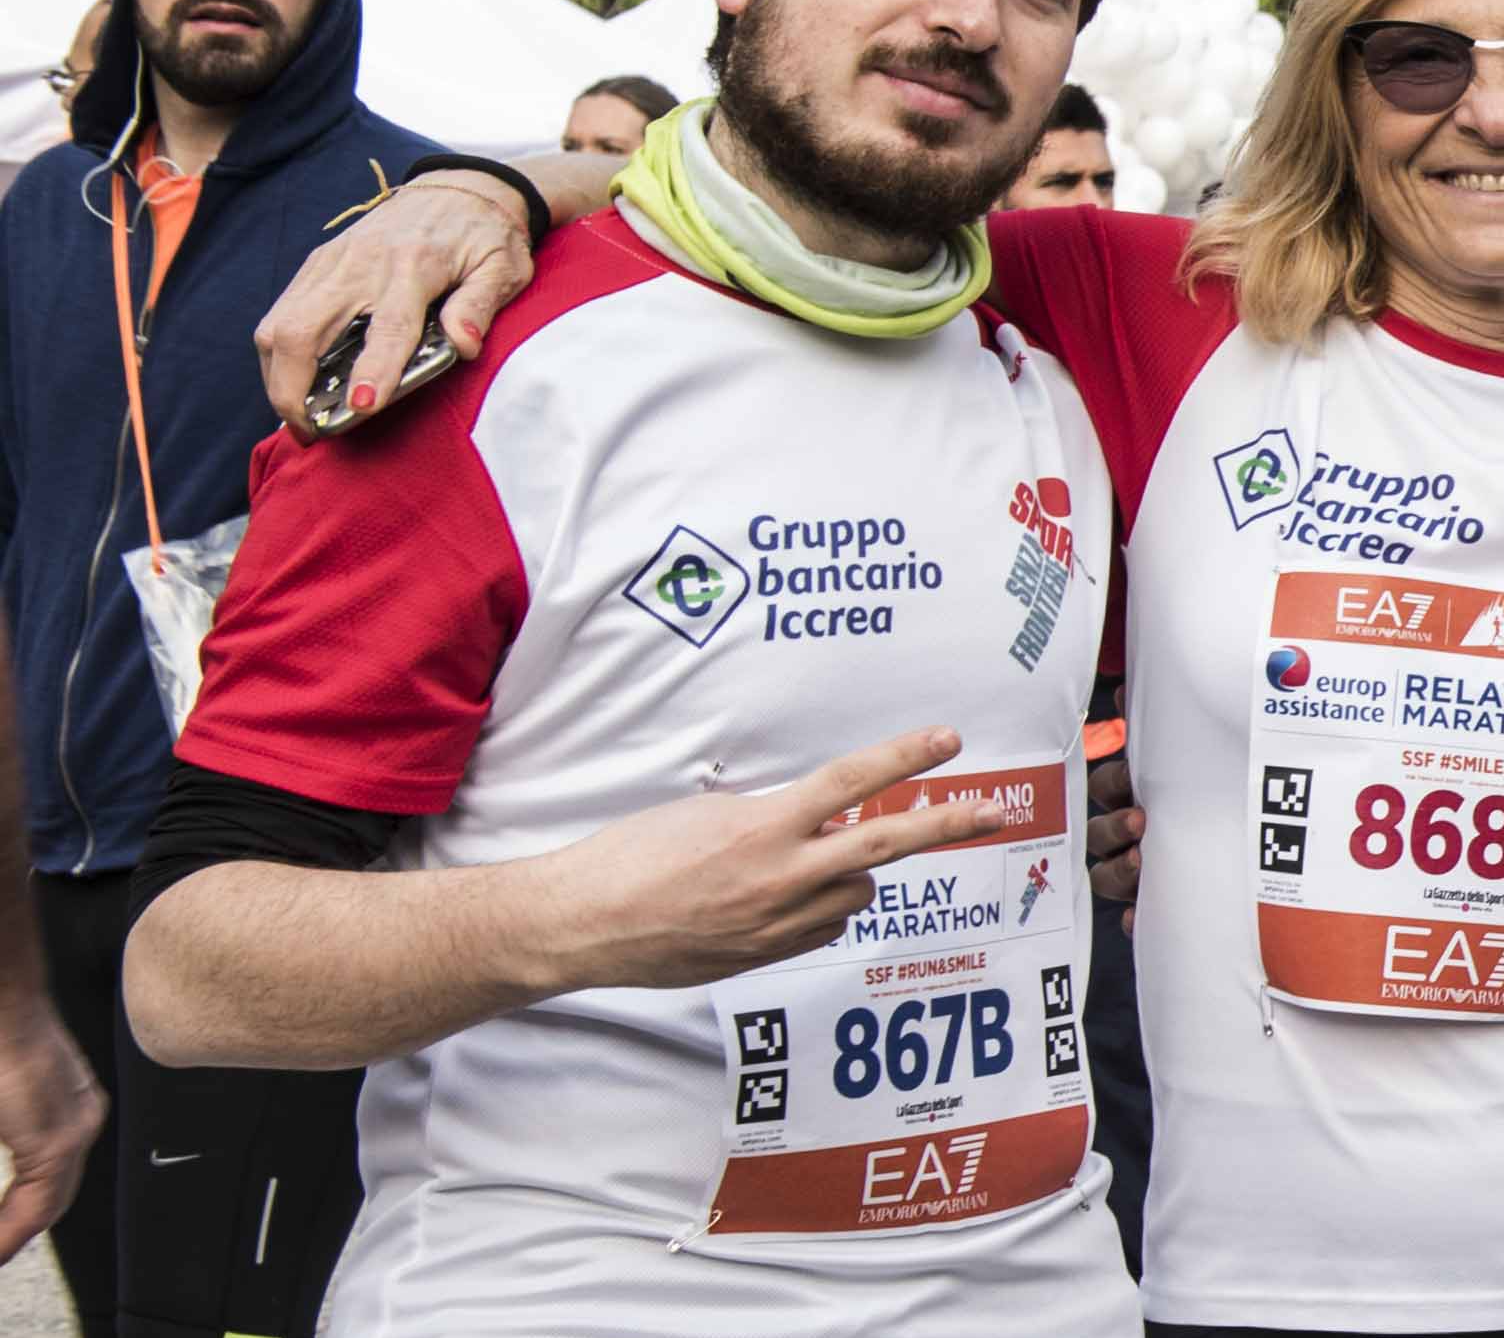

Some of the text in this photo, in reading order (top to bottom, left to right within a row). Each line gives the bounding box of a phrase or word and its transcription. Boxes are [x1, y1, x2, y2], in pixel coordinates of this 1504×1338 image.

[748, 515, 905, 557] Gruppo
[757, 553, 942, 597] bancario
[1006, 533, 1044, 608] SENZA
[764, 604, 892, 640] Iccrea
[1336, 587, 1436, 629] EA7
[1316, 674, 1387, 700] europ
[1264, 695, 1385, 723] assistance
[1401, 750, 1435, 768] SSF
[856, 901, 1000, 943] MARATHON
[865, 952, 986, 985] SSF #RUN&SMILE
[1381, 983, 1448, 1002] EMPORIO
[833, 988, 1014, 1099] 867B
[862, 1132, 988, 1205] EA7
[858, 1192, 988, 1223] EMPORIO ARMANI
